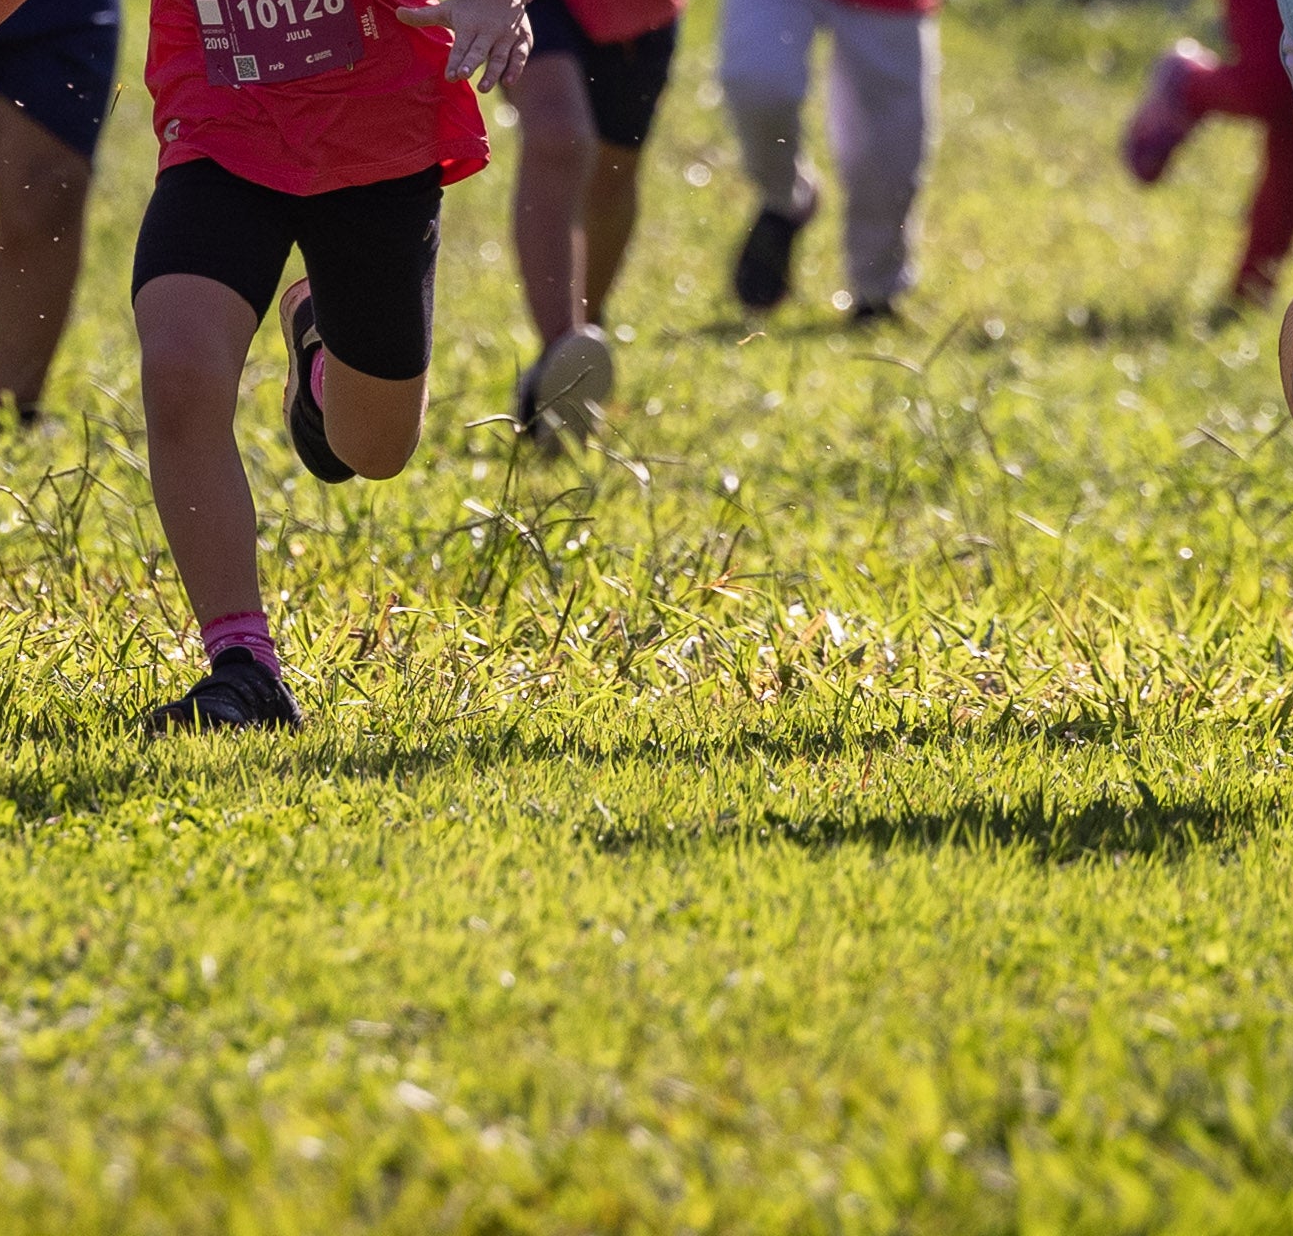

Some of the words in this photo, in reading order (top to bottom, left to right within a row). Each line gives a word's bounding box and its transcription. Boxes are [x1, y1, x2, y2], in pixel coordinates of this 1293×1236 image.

[285, 29, 312, 42] JULIA
[204, 37, 229, 50] 2019
[268, 61, 285, 71] rvb
